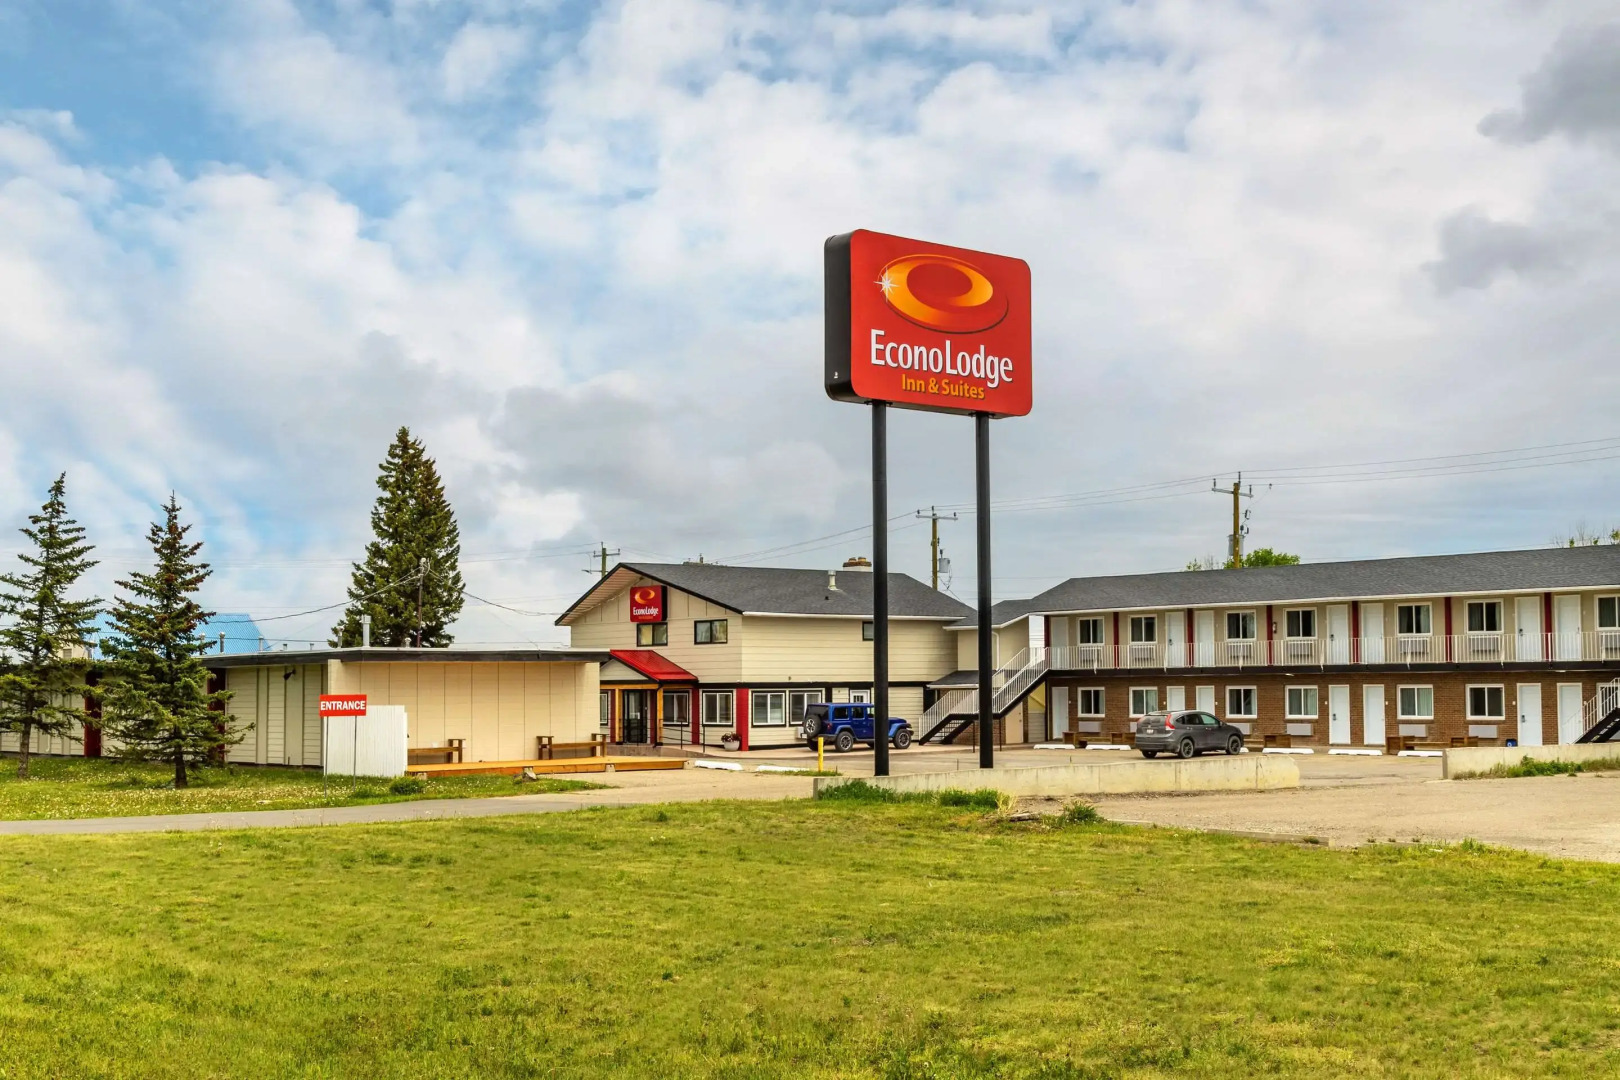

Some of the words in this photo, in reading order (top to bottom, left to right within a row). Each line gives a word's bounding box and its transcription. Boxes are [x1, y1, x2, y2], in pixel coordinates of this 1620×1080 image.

[870, 328, 1013, 388] EconoLodge
[901, 374, 926, 392] Inn
[928, 377, 940, 394] &
[941, 381, 985, 399] Suites
[320, 701, 366, 711] ENTRANCE
